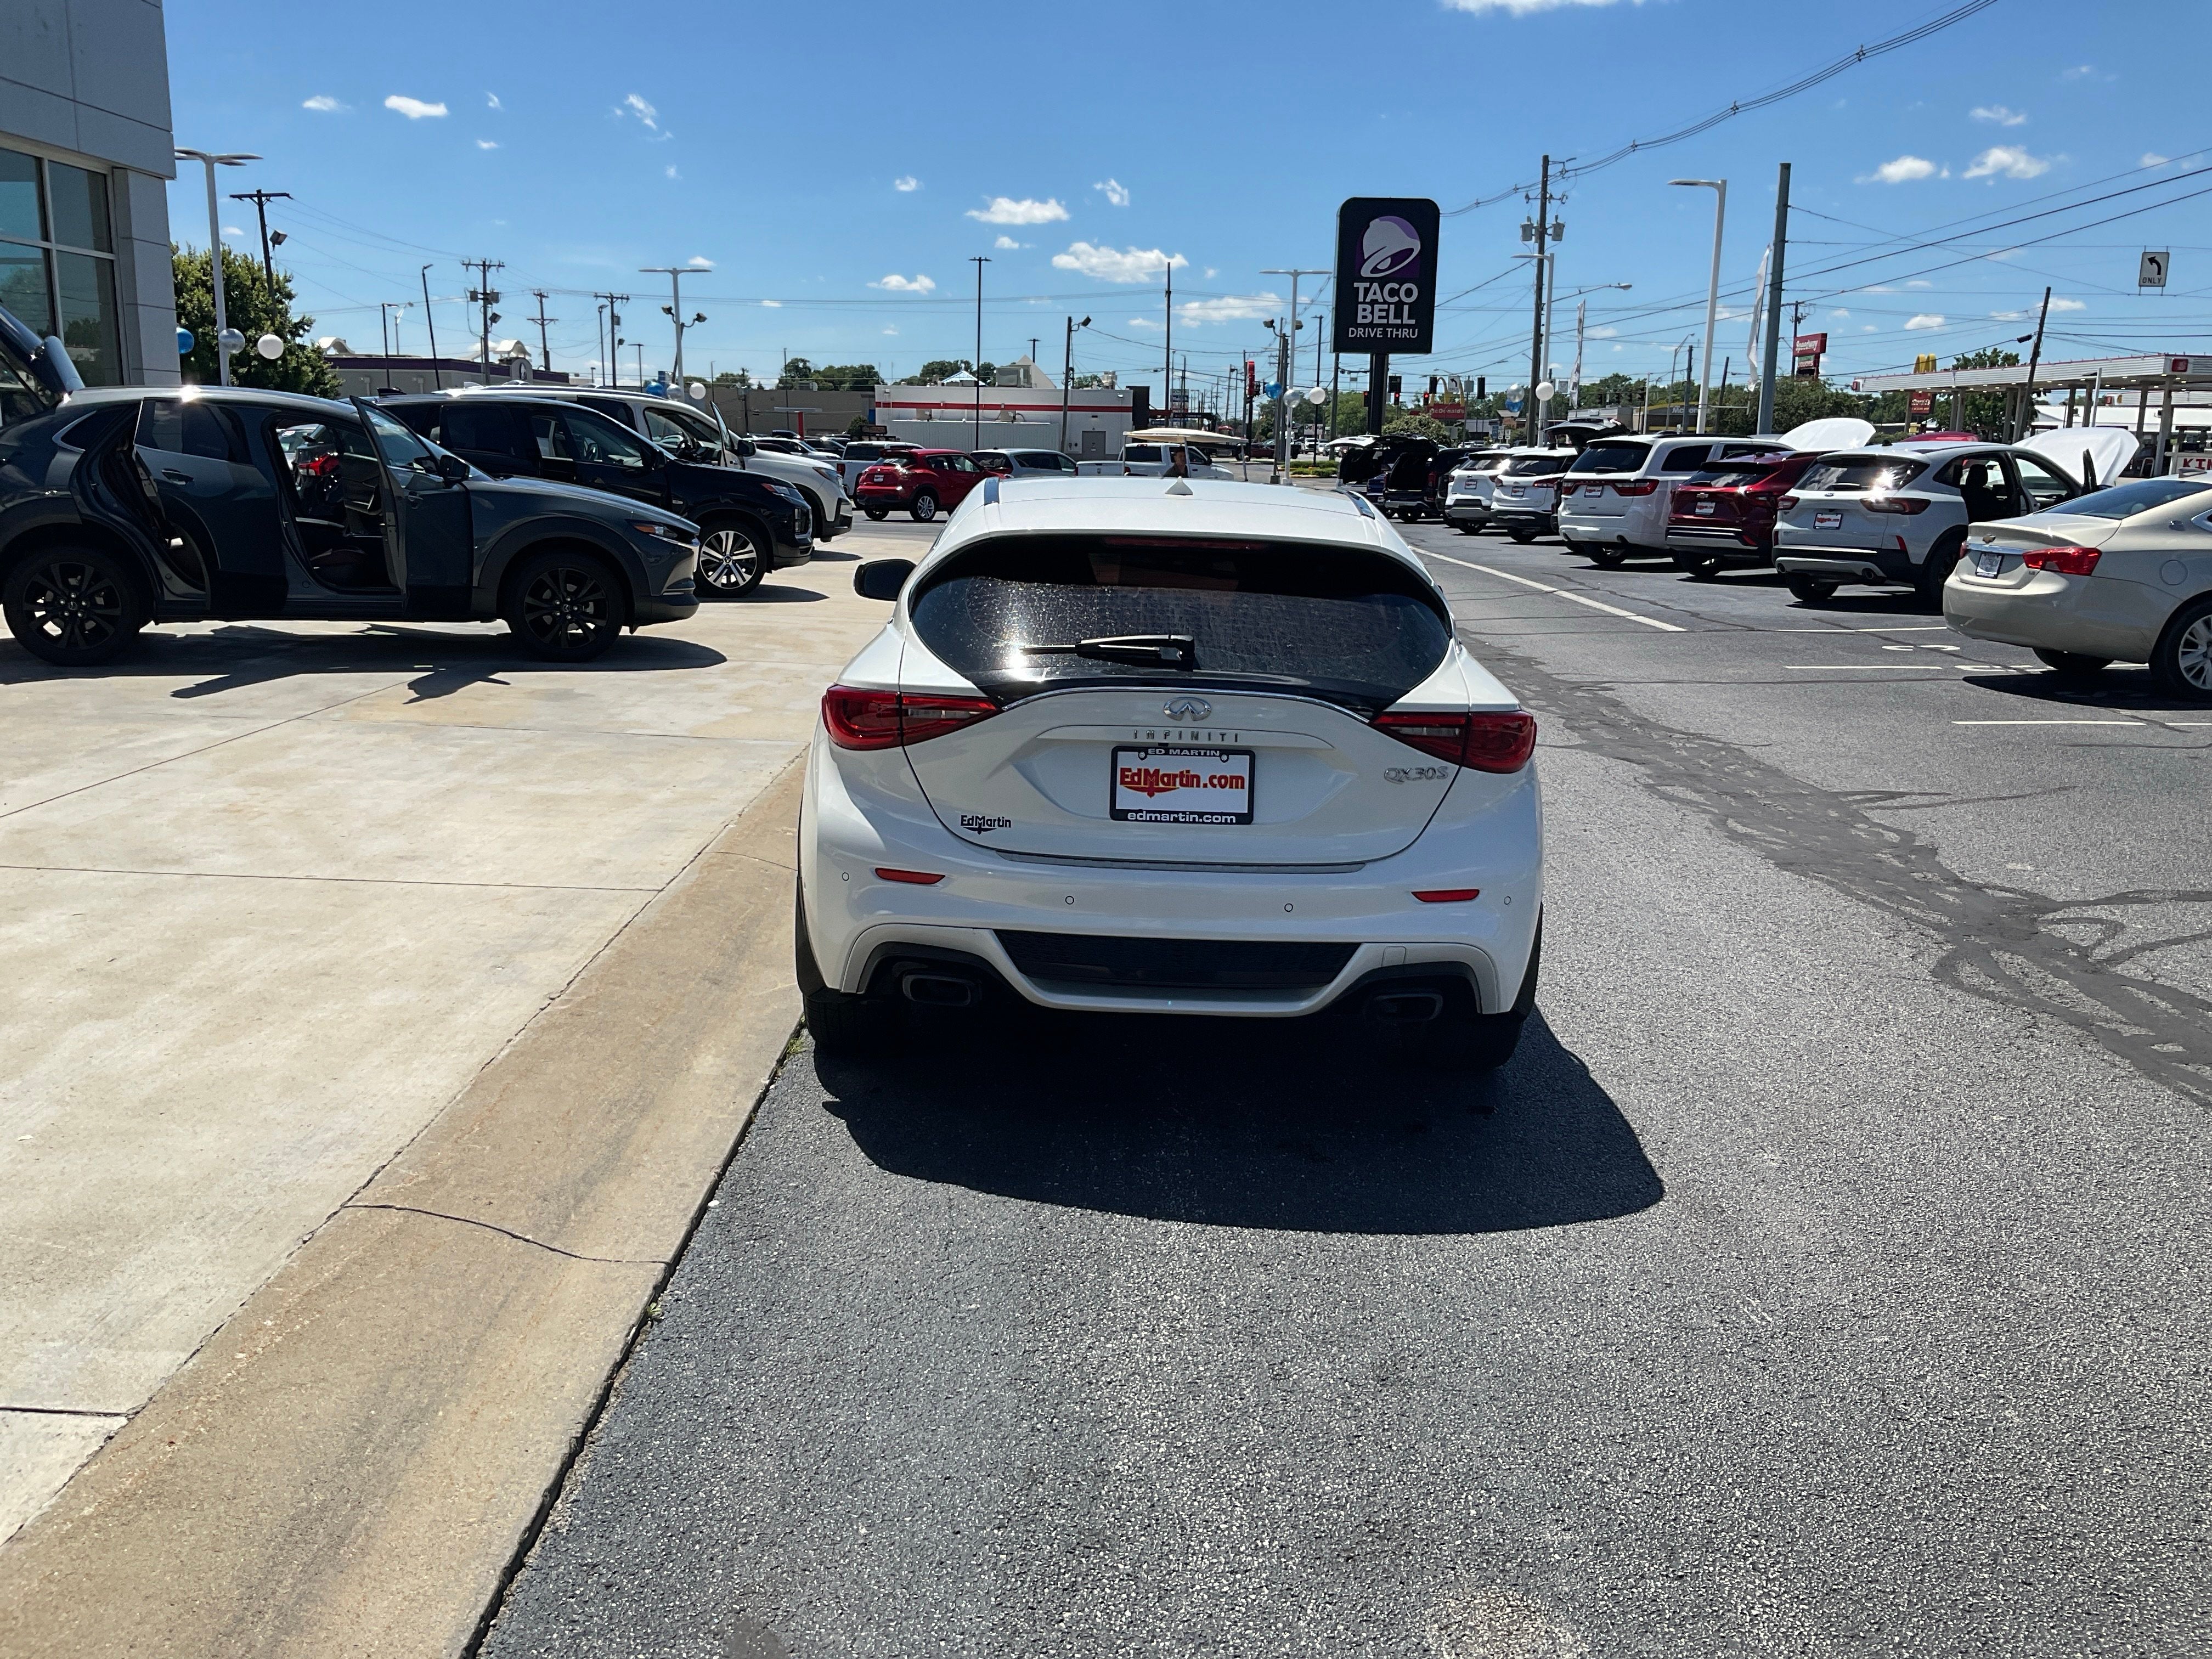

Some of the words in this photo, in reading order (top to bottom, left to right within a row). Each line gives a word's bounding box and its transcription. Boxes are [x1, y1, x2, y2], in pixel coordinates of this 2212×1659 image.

[1353, 283, 1418, 303] TACO
[1357, 304, 1415, 324] BELL
[1348, 328, 1383, 338] DRIVE
[1386, 328, 1418, 338] THRU
[1133, 730, 1238, 742] INFINITI
[1120, 768, 1245, 791] EdMartin.com
[961, 815, 1012, 830] EdMartin
[1127, 811, 1237, 823] edmartin.com
